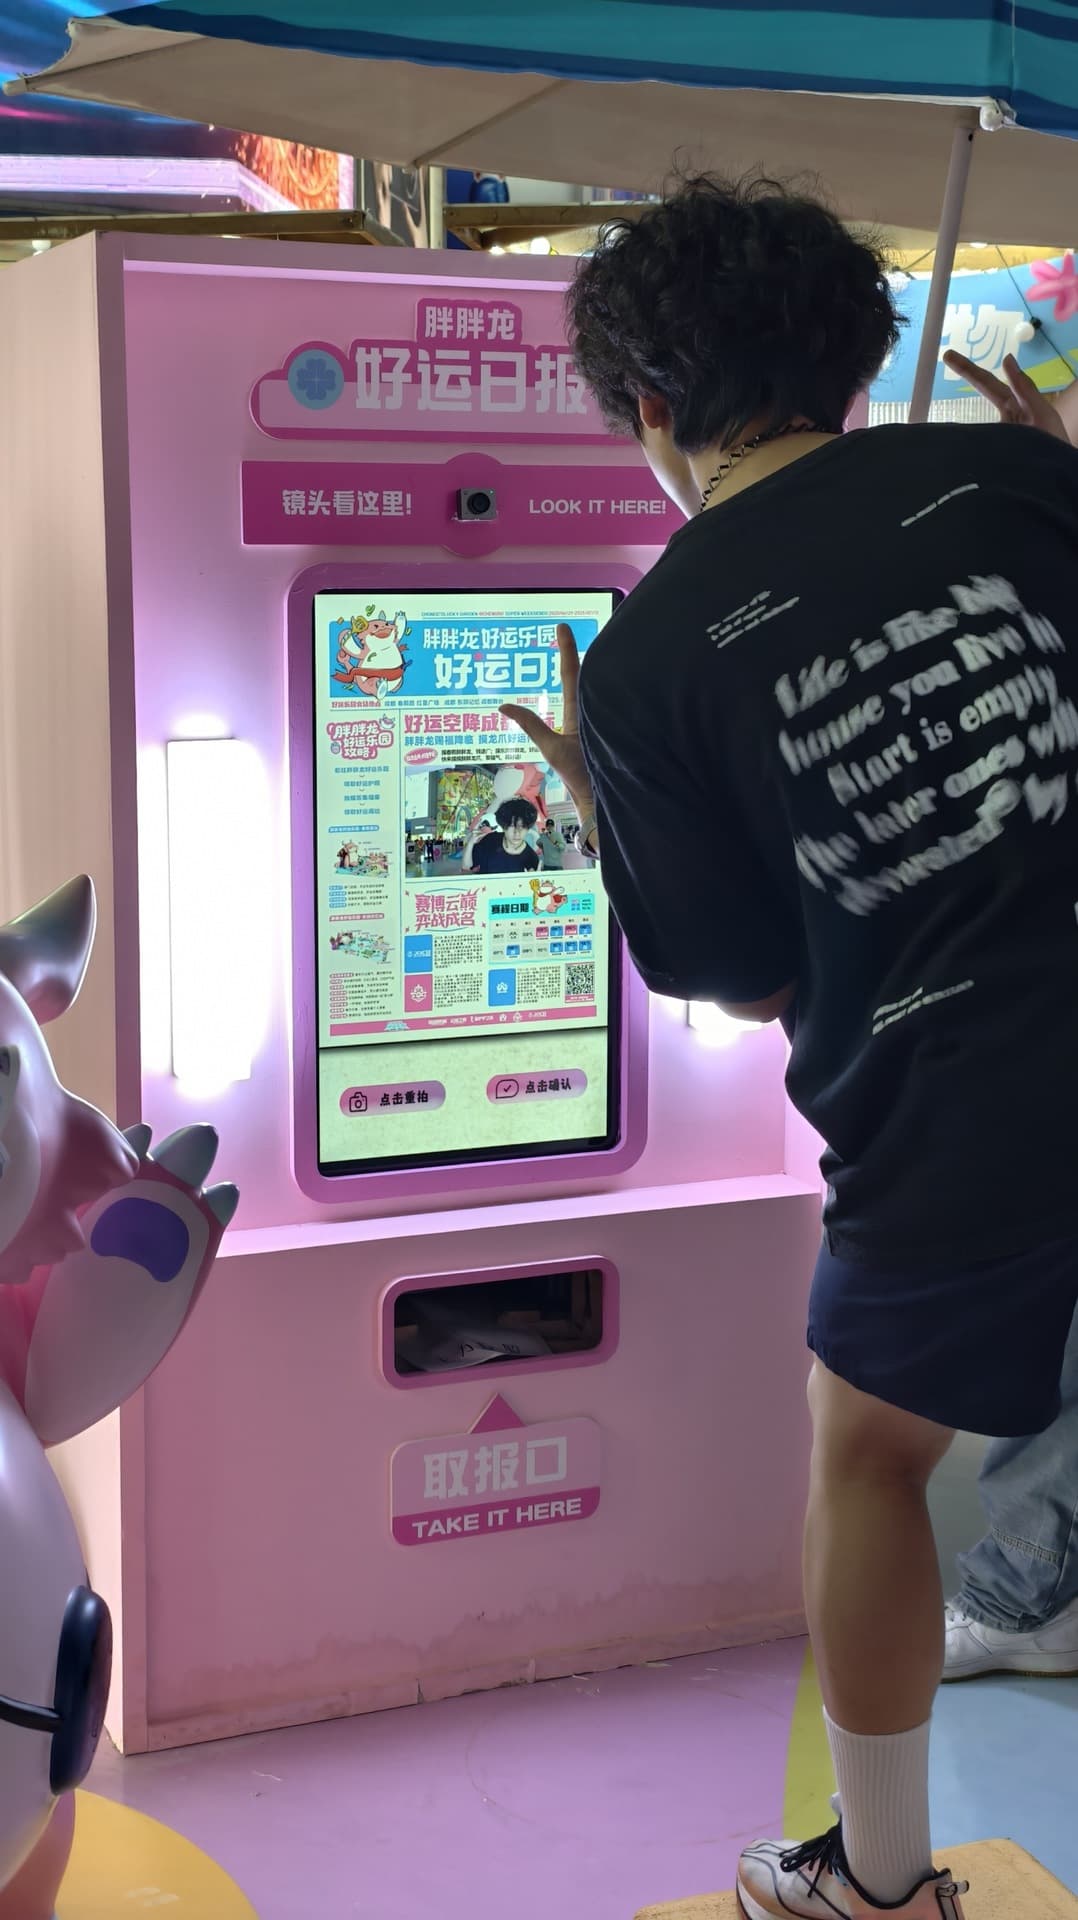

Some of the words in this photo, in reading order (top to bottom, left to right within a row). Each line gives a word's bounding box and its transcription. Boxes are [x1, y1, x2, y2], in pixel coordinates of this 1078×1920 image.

[425, 306, 516, 340] 胖胖龙
[354, 346, 589, 415] 好运日报
[529, 500, 581, 514] LOOK
[587, 500, 604, 514] IT
[610, 500, 667, 515] HERE!
[423, 623, 558, 650] 胖胖龙好运乐园
[888, 659, 962, 716] you
[478, 733, 531, 745] 摸龙爪好运
[919, 716, 953, 751] is
[414, 888, 480, 914] 赛博云巅
[490, 902, 529, 915] 赛程日期
[379, 1090, 429, 1106] 点击重拍
[524, 1077, 572, 1094] 点击确认
[423, 1436, 567, 1500] 取报口
[412, 1513, 480, 1539] TAKE
[487, 1508, 510, 1527] IT
[515, 1497, 582, 1523] HERE
